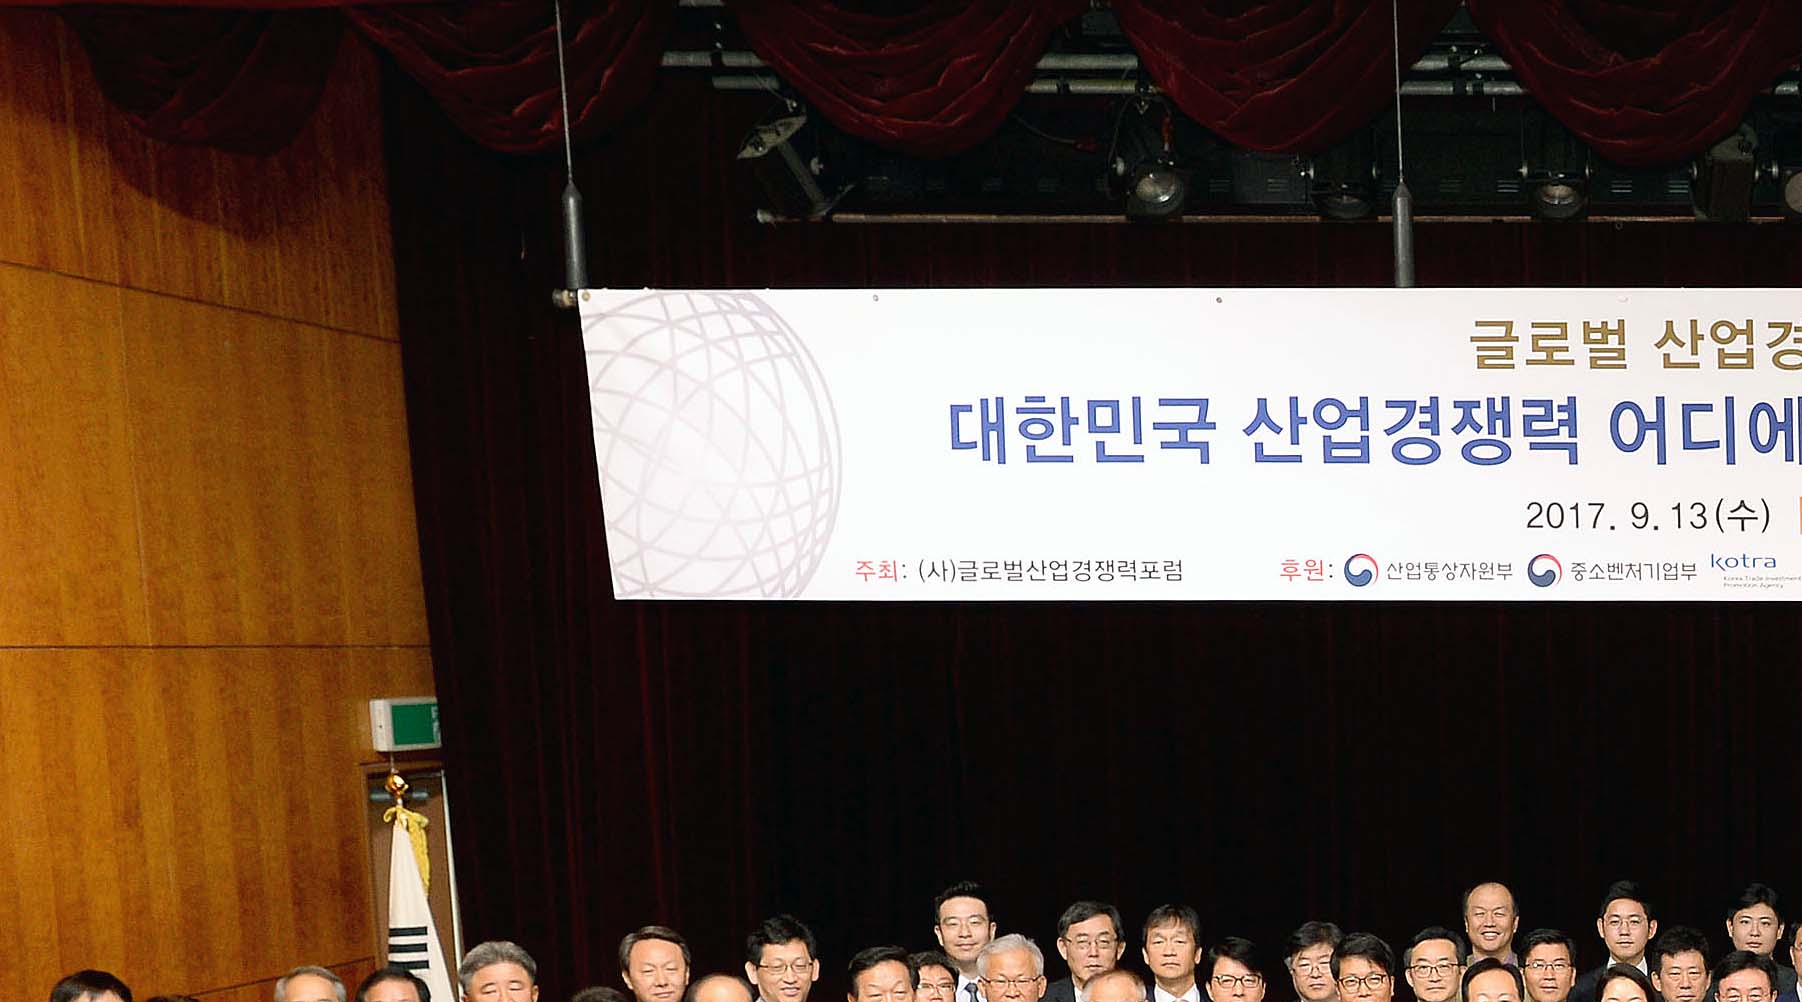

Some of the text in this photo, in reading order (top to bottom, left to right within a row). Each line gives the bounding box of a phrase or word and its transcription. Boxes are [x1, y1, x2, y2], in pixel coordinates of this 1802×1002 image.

[1469, 318, 1628, 370] 글로벌
[949, 395, 1217, 466] 대한민국
[1241, 395, 1579, 467] 산업경쟁력
[1526, 497, 1770, 534] 2017. 9. 13(수)
[855, 559, 1183, 583] 주최: (사)글로벌산업경쟁력포럼
[1279, 559, 1334, 583] 후원:
[1386, 562, 1513, 581] 산업통상자원부
[1570, 562, 1698, 581] 중소벤처기업부
[1711, 553, 1777, 572] kotra
